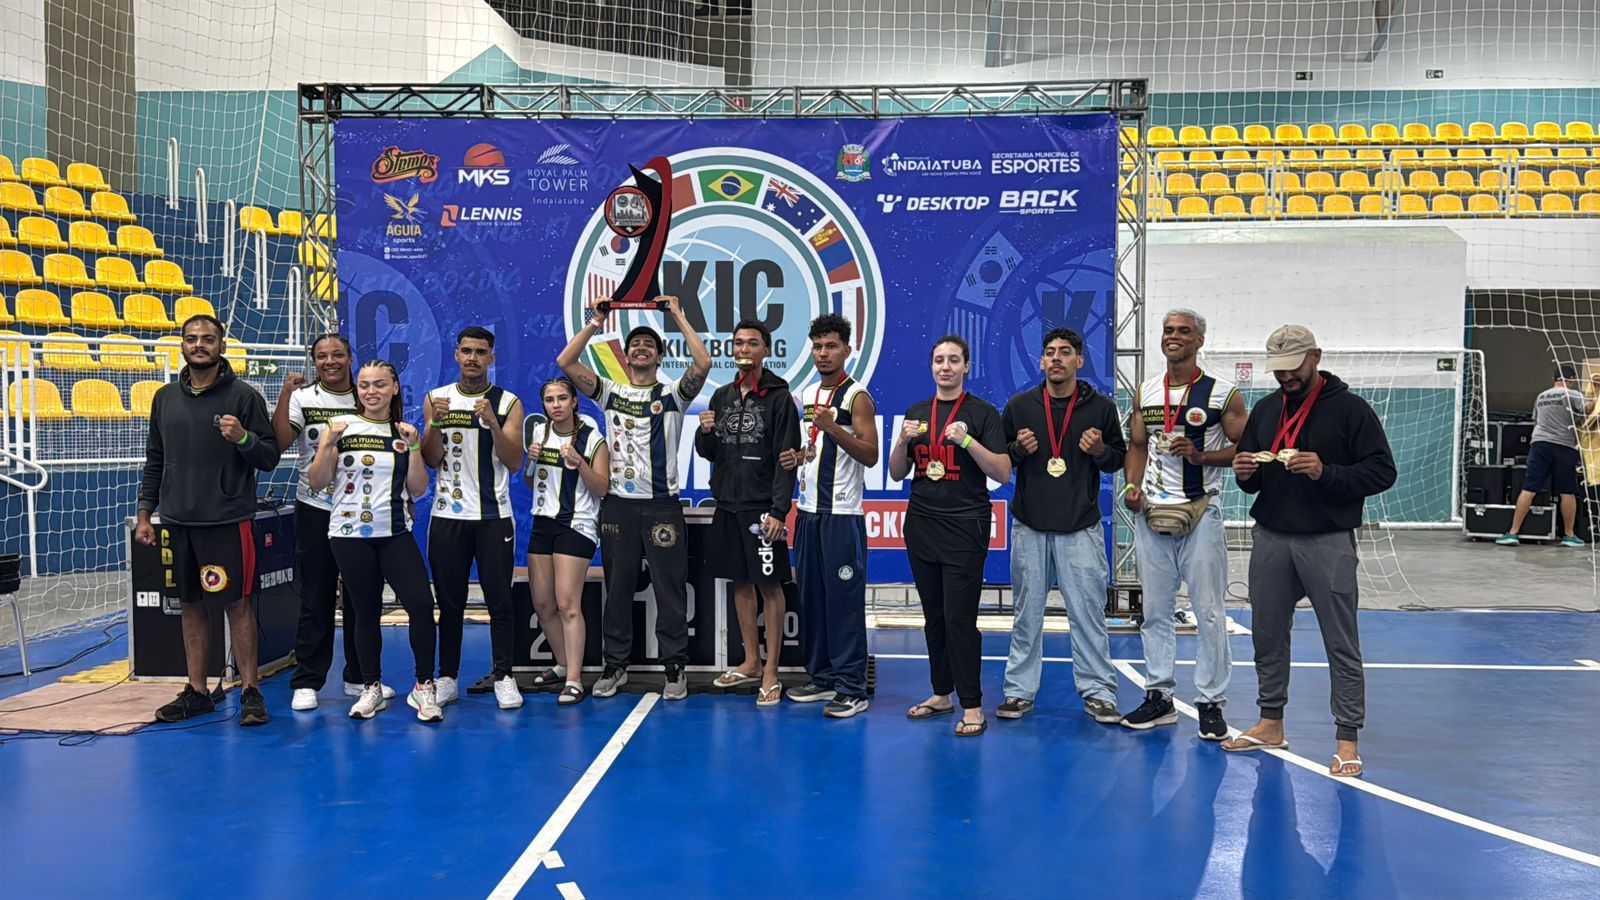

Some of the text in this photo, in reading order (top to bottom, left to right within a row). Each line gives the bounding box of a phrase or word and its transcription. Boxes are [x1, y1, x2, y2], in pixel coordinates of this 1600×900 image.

[893, 159, 983, 171] INDAIATUBA
[991, 158, 1081, 174] ESPORTES
[458, 169, 510, 188] MKS
[527, 169, 588, 177] ROYAL PALM
[528, 178, 588, 191] TOWER
[906, 197, 990, 211] DESKTOP
[999, 189, 1080, 208] BACK
[460, 207, 522, 221] LENNIS
[386, 222, 422, 236] ÁGUIA
[662, 258, 785, 334] KIC
